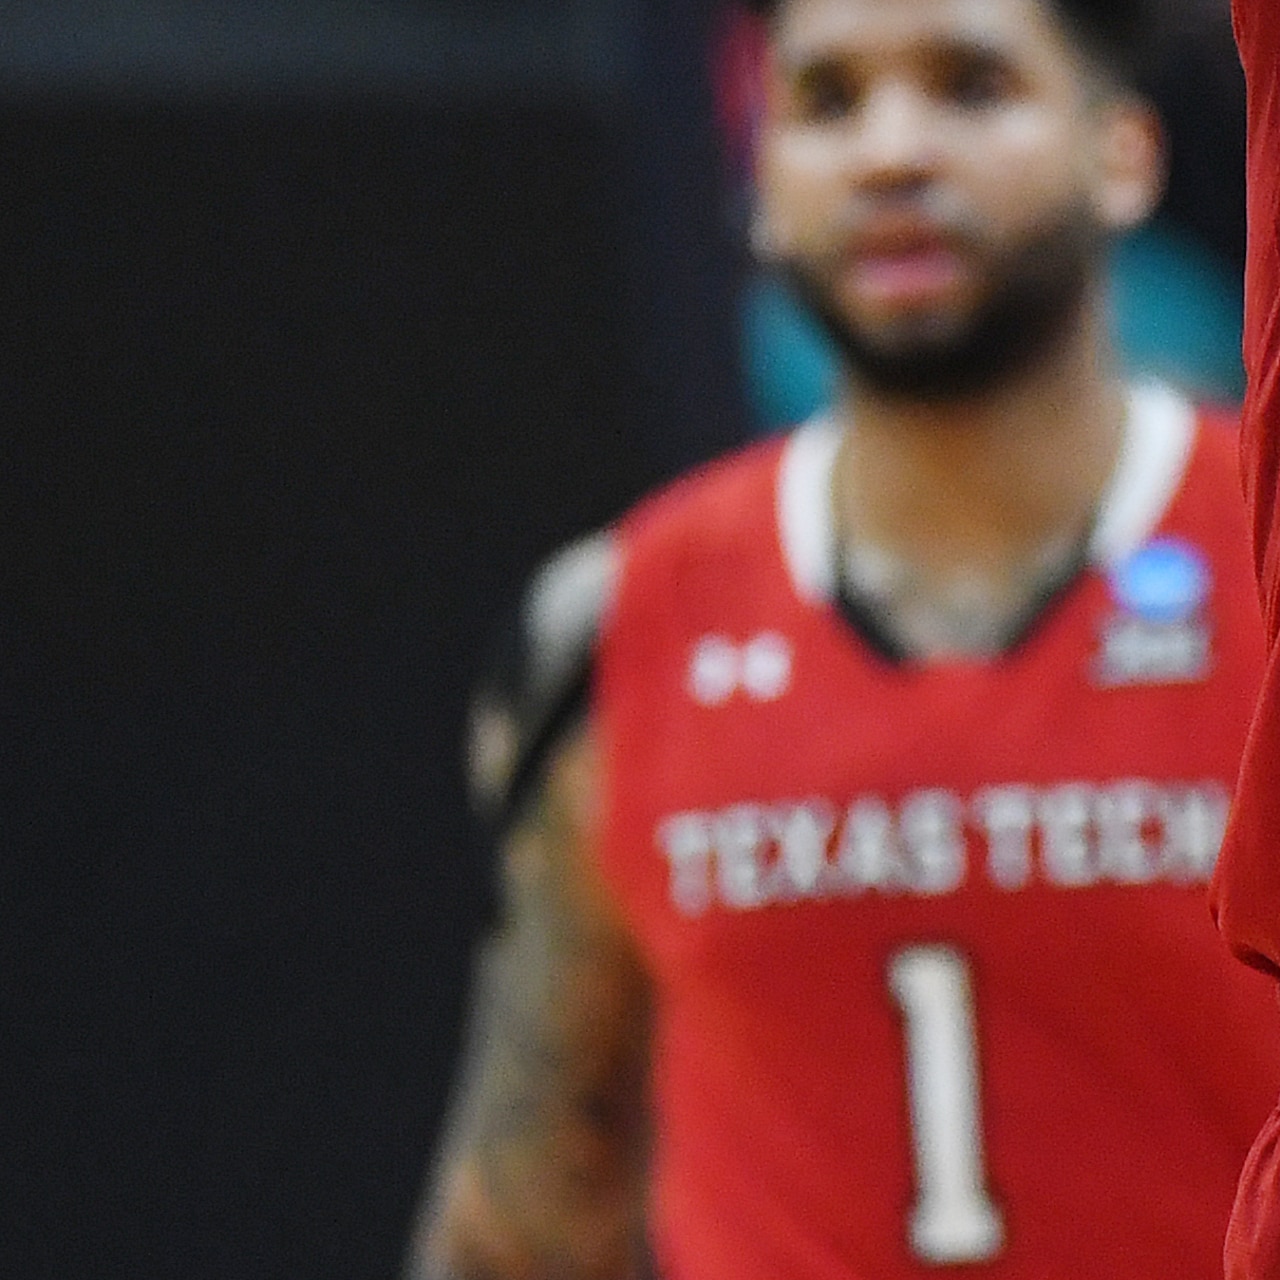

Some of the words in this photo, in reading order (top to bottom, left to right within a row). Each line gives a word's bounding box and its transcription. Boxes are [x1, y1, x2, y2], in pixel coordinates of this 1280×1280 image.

[656, 784, 968, 916] TEXAS
[971, 778, 1230, 890] TECH
[886, 941, 1005, 1265] 1
